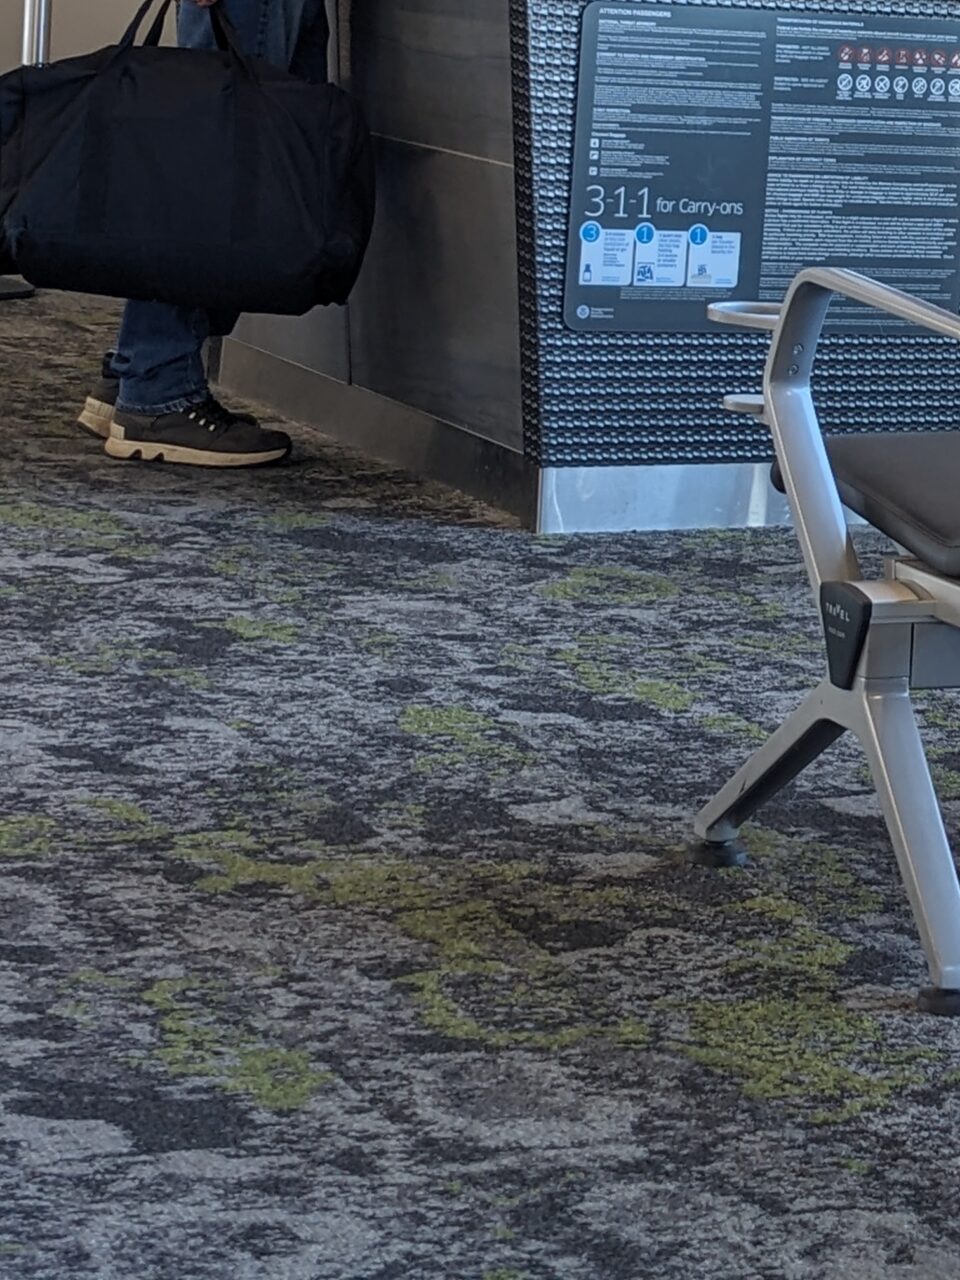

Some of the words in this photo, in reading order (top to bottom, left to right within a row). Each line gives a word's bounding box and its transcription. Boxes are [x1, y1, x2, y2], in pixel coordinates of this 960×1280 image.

[584, 184, 652, 218] 3-1-1
[656, 197, 676, 213] for
[679, 198, 743, 217] Carry-ons
[586, 224, 597, 241] 3
[641, 226, 648, 242] 1
[695, 228, 703, 243] 1
